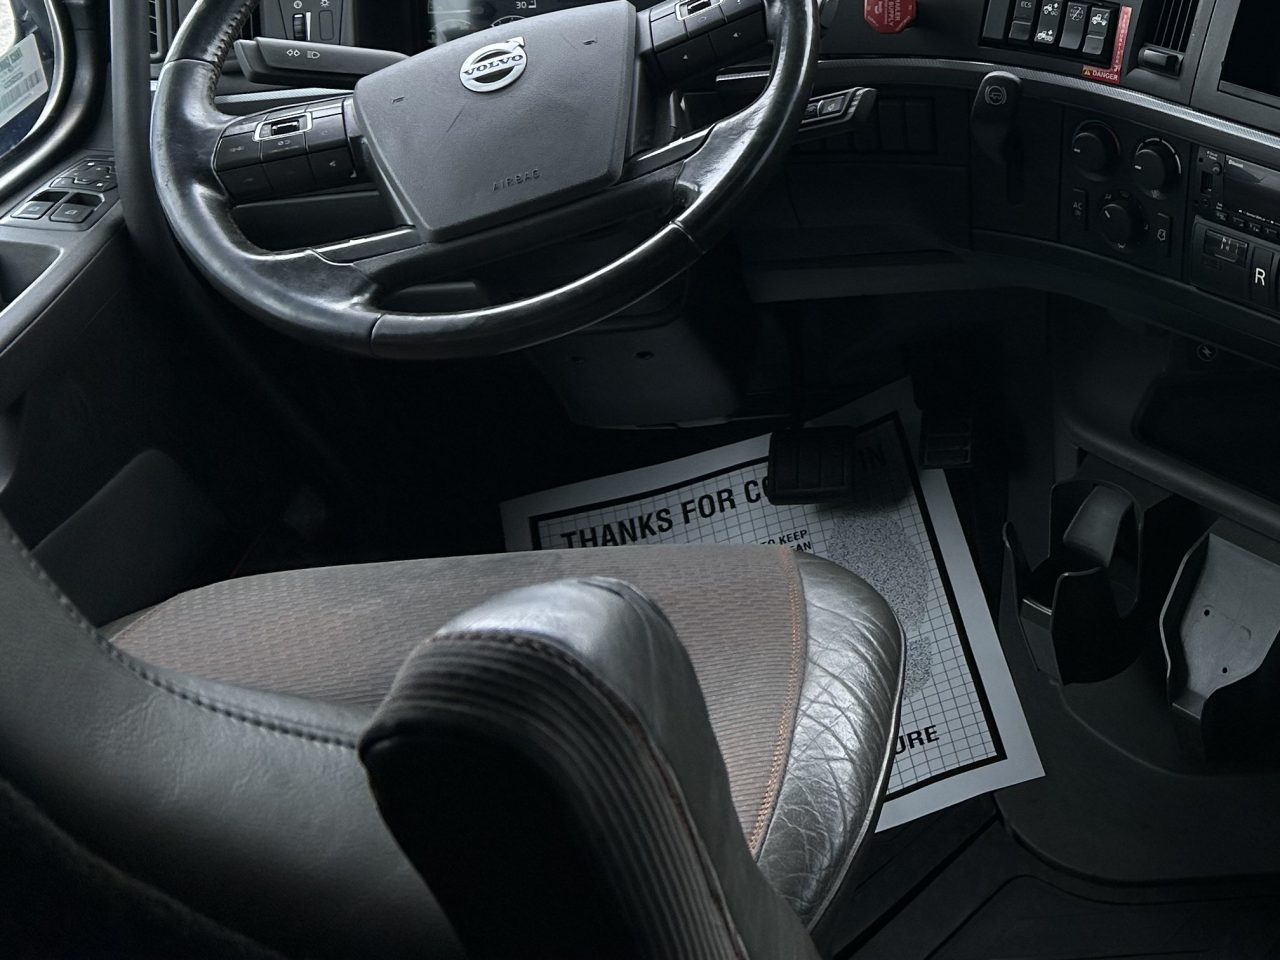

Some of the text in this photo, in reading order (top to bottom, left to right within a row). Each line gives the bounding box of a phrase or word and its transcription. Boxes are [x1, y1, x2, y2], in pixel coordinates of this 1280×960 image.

[516, 1, 527, 9] 30
[1020, 0, 1032, 9] ECS
[462, 54, 524, 76] VOLVO
[1091, 70, 1118, 81] DANGER
[493, 169, 541, 191] AIRBAG
[1255, 268, 1266, 286] R
[560, 508, 673, 549] THANKS
[680, 488, 736, 525] FOR
[779, 530, 808, 545] KEEP
